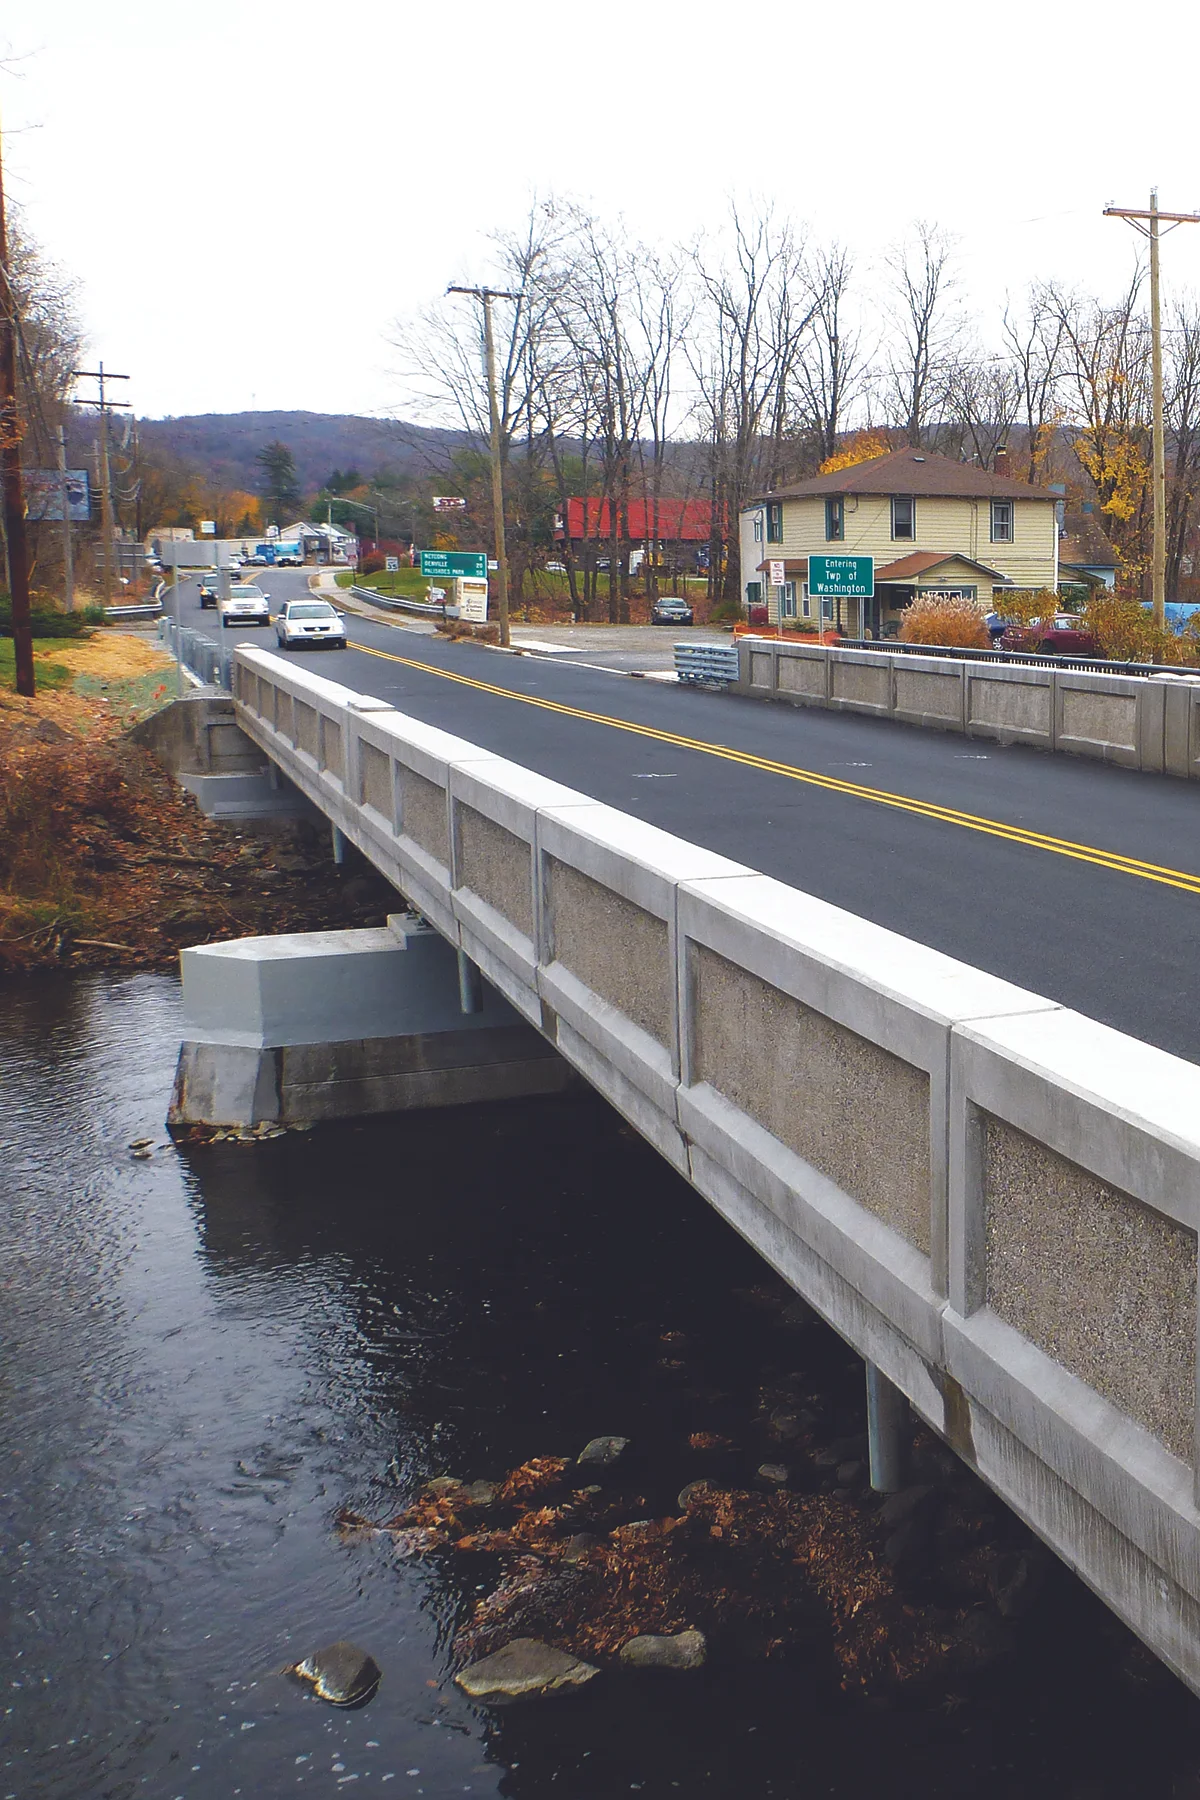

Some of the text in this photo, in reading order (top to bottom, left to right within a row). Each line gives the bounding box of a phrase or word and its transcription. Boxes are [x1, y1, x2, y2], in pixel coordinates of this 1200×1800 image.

[825, 559, 857, 570] Entering
[825, 571, 857, 582] Twp of
[817, 583, 866, 595] Washington
